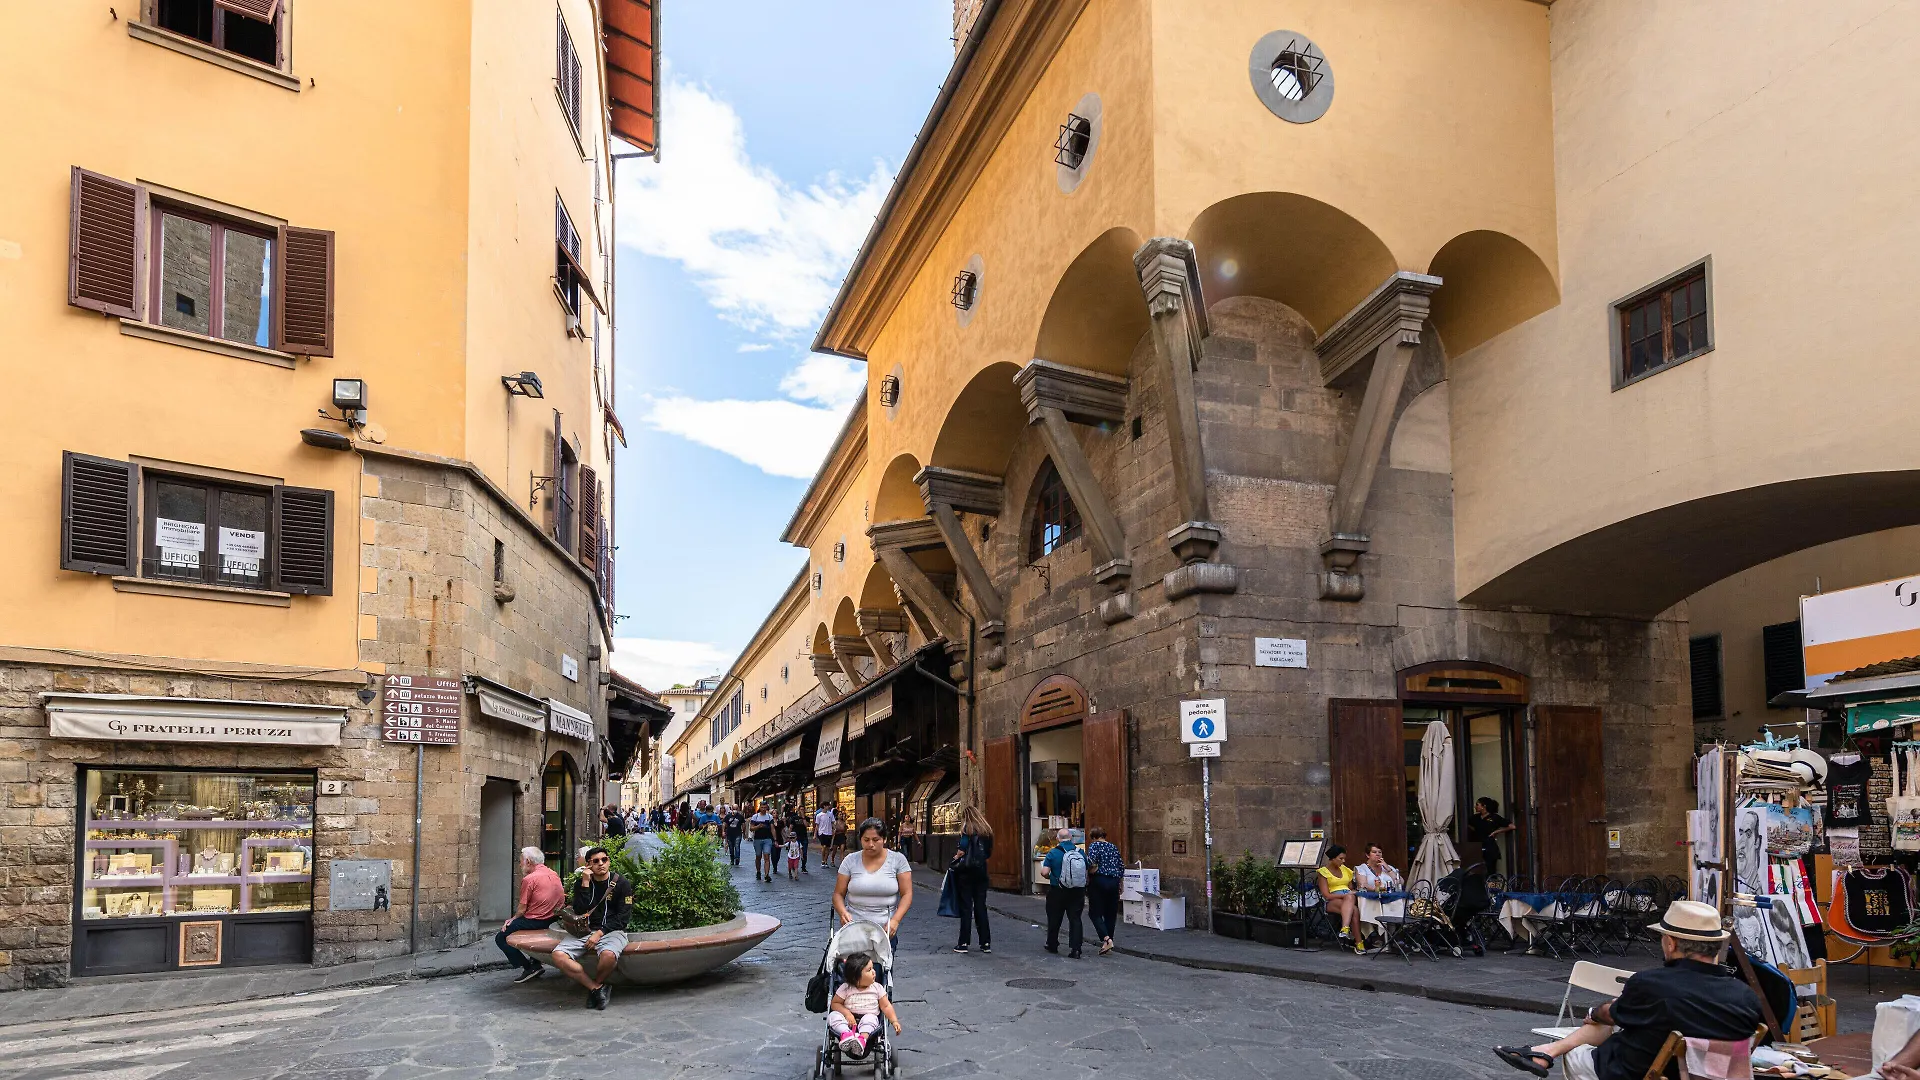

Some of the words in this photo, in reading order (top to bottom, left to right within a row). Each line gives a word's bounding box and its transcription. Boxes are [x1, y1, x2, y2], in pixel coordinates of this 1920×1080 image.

[164, 552, 198, 562] UFFICIO
[226, 560, 258, 570] UFFICIO
[133, 724, 216, 734] FRATELLI
[224, 727, 292, 737] PERUZZI
[556, 714, 589, 736] MANNELLI
[820, 737, 840, 756] U-BOAT
[328, 784, 335, 792] 2
